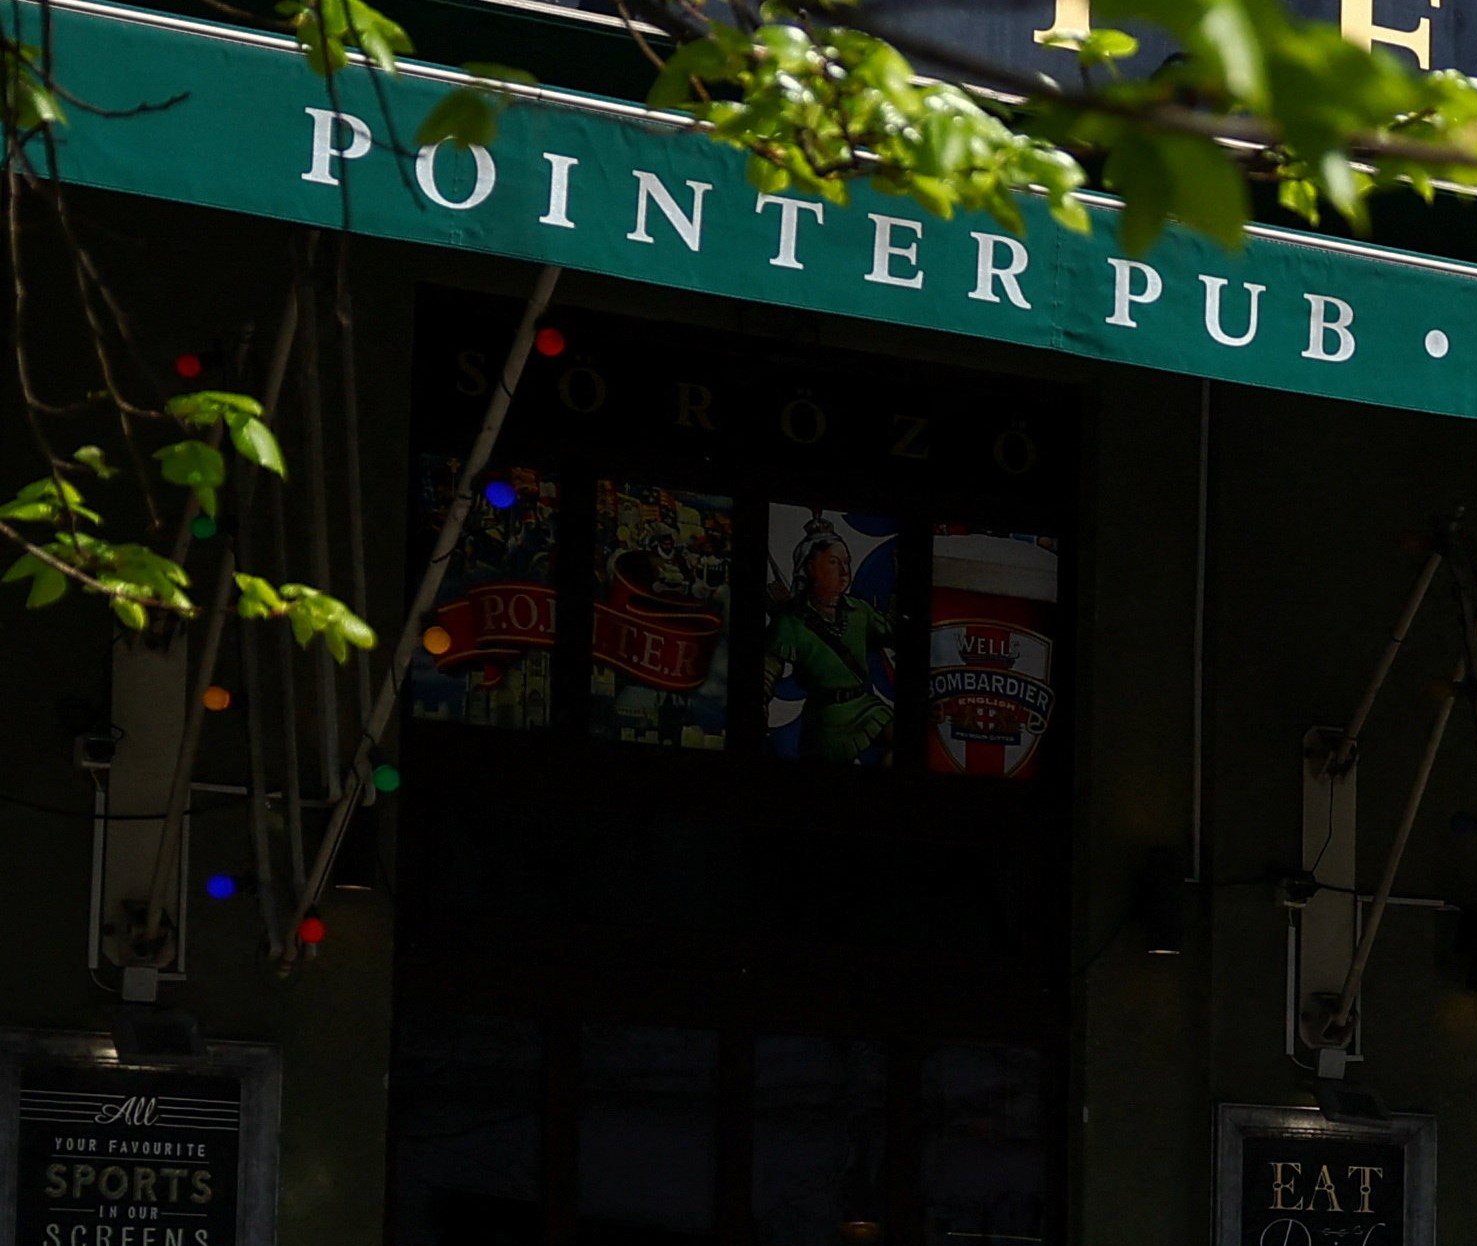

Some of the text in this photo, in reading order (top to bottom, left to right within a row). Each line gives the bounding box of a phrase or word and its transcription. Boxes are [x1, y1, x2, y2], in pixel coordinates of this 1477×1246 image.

[301, 106, 1032, 311] POINTER
[1105, 257, 1357, 363] PUB
[95, 1095, 159, 1127] All
[53, 1136, 207, 1158] YOUR FAVOURITE
[44, 1162, 215, 1205] SPORTS
[1268, 1161, 1384, 1214] EAT
[99, 1204, 160, 1221] IN OUR
